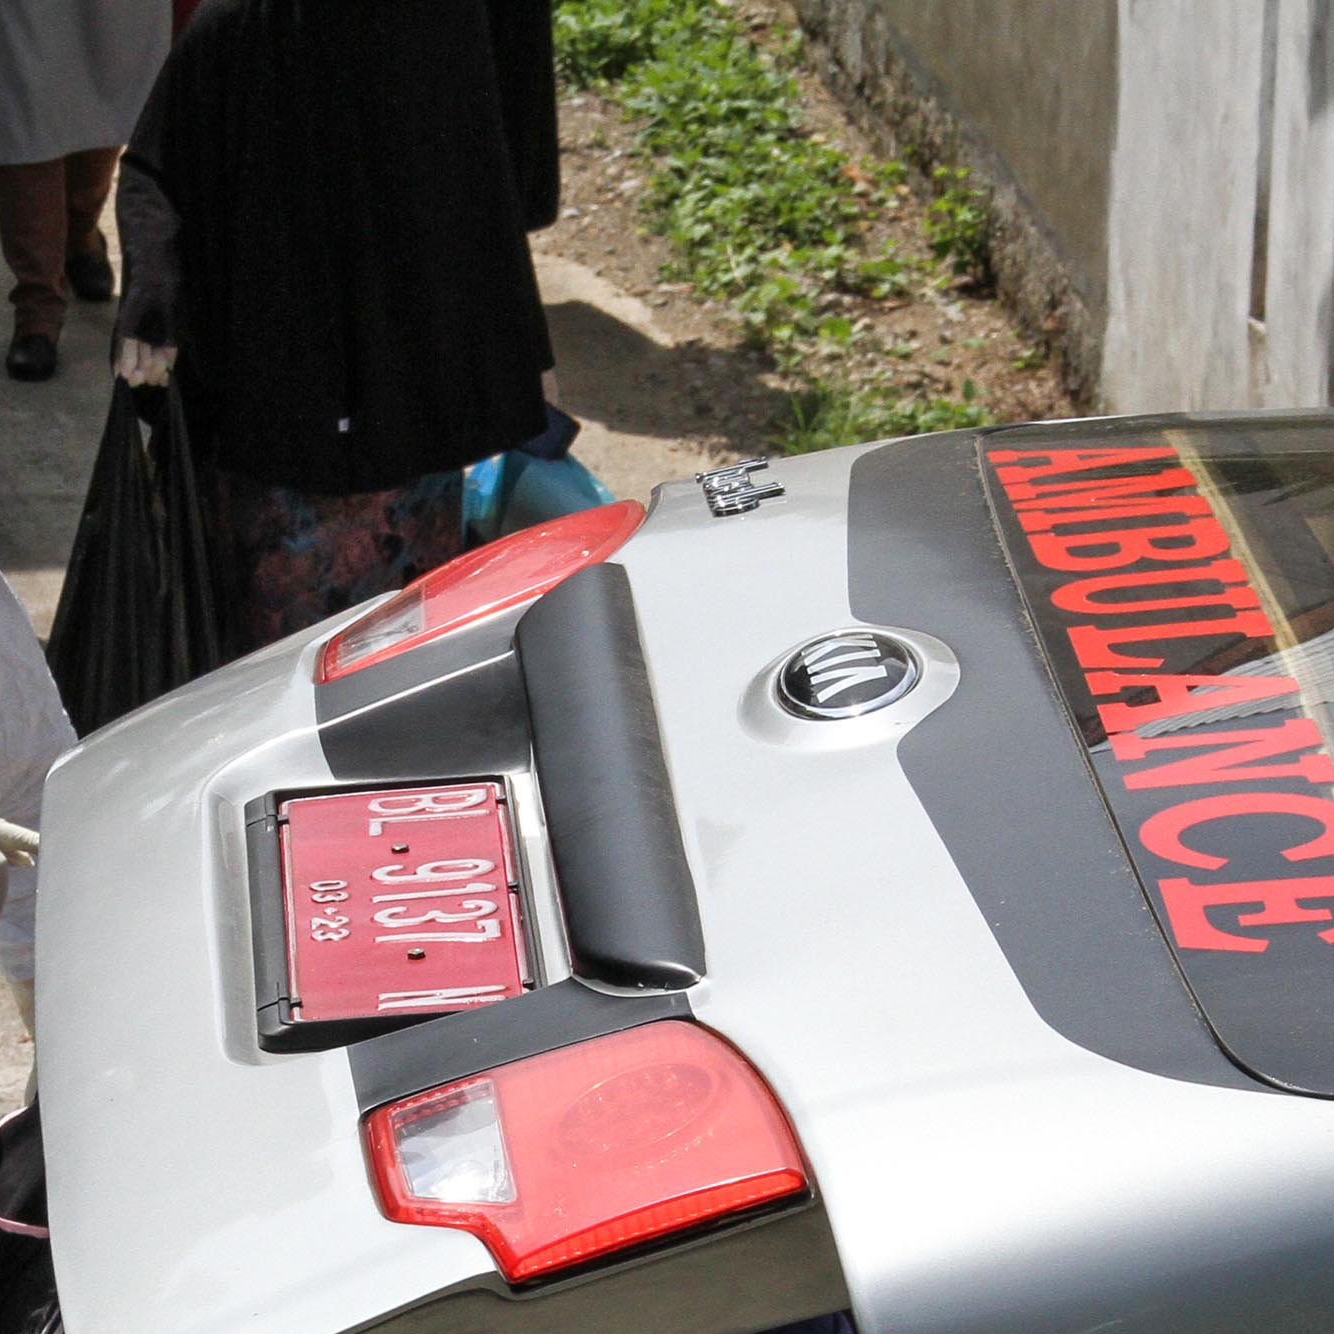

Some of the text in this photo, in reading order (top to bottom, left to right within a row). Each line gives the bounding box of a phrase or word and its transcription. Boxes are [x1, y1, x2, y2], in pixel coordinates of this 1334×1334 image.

[801, 634, 888, 704] KIA
[366, 788, 508, 1012] BL 9137 N
